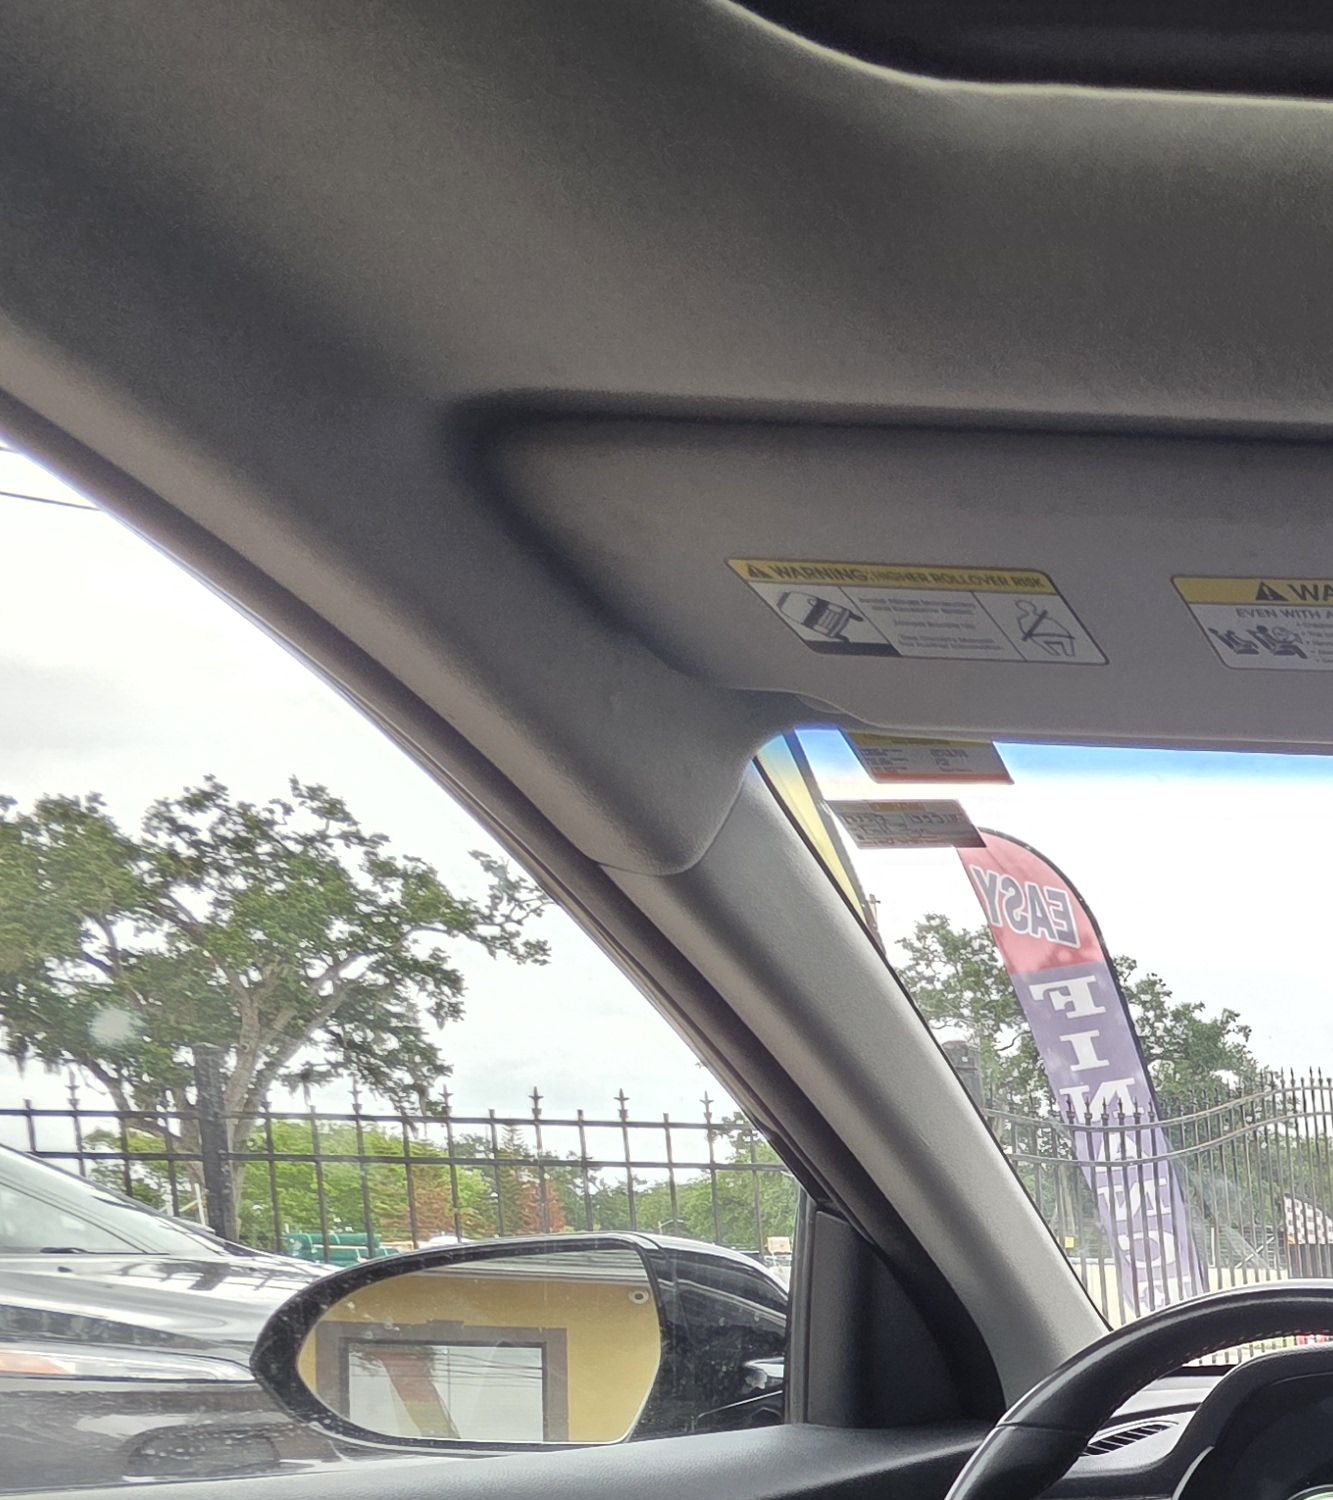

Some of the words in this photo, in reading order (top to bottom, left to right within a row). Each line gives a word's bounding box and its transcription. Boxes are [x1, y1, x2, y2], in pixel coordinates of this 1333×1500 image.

[929, 573, 1011, 587] ROLLOVER
[1010, 576, 1045, 589] RISK
[1236, 609, 1278, 619] EVEN
[1280, 609, 1321, 620] WITH
